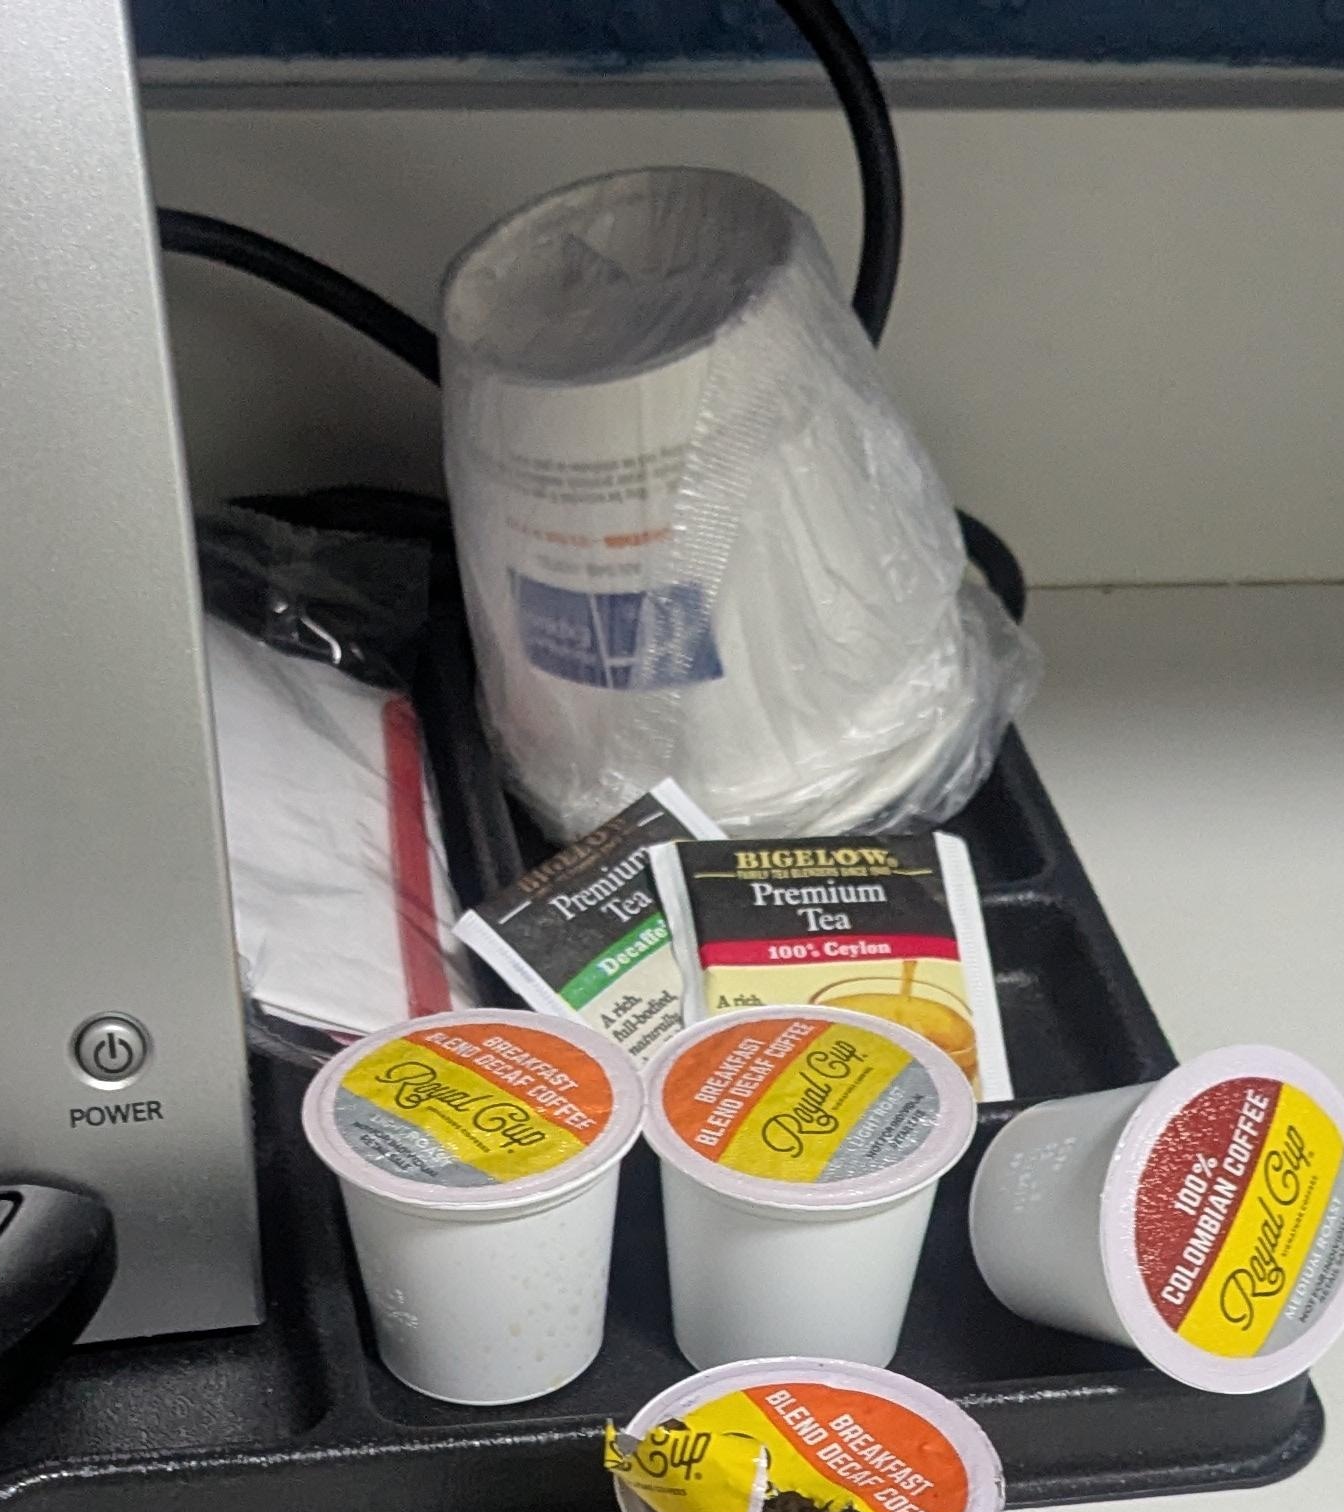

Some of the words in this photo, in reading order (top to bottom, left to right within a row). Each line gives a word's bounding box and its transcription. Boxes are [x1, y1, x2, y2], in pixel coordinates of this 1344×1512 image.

[733, 847, 891, 869] BIGELOW
[600, 889, 653, 923] Tea
[750, 878, 888, 906] Premium
[796, 907, 852, 932] Tea
[823, 941, 892, 958] Ceylon
[600, 1013, 615, 1029] A
[717, 995, 730, 1009] A
[425, 1032, 482, 1059] BLEND
[472, 1048, 533, 1088] DECAF
[526, 1084, 596, 1132] COFFEE
[481, 1035, 579, 1093] BREAKFAST
[694, 1037, 766, 1104] BREAKFAST
[694, 1097, 745, 1147] BLEND
[735, 1058, 776, 1099] DECAF
[765, 1021, 814, 1060] COFFEE
[69, 1100, 164, 1128] POWER
[374, 1060, 495, 1110] Royal
[472, 1095, 548, 1148] Cup
[761, 1071, 840, 1159] Royal
[806, 1040, 864, 1080] Cup
[1160, 1161, 1237, 1307] COLOMBIAN
[1227, 1088, 1271, 1178] COFFEE
[1172, 1151, 1218, 1216] 100%
[1220, 1197, 1286, 1331] Royal
[1264, 1125, 1311, 1206] Cup
[1284, 1252, 1323, 1321] MEDIUM
[1316, 1196, 1343, 1253] ROAST
[763, 1388, 830, 1448] BLEND
[815, 1440, 879, 1490] DECAF
[827, 1412, 936, 1497] BREAKFAST
